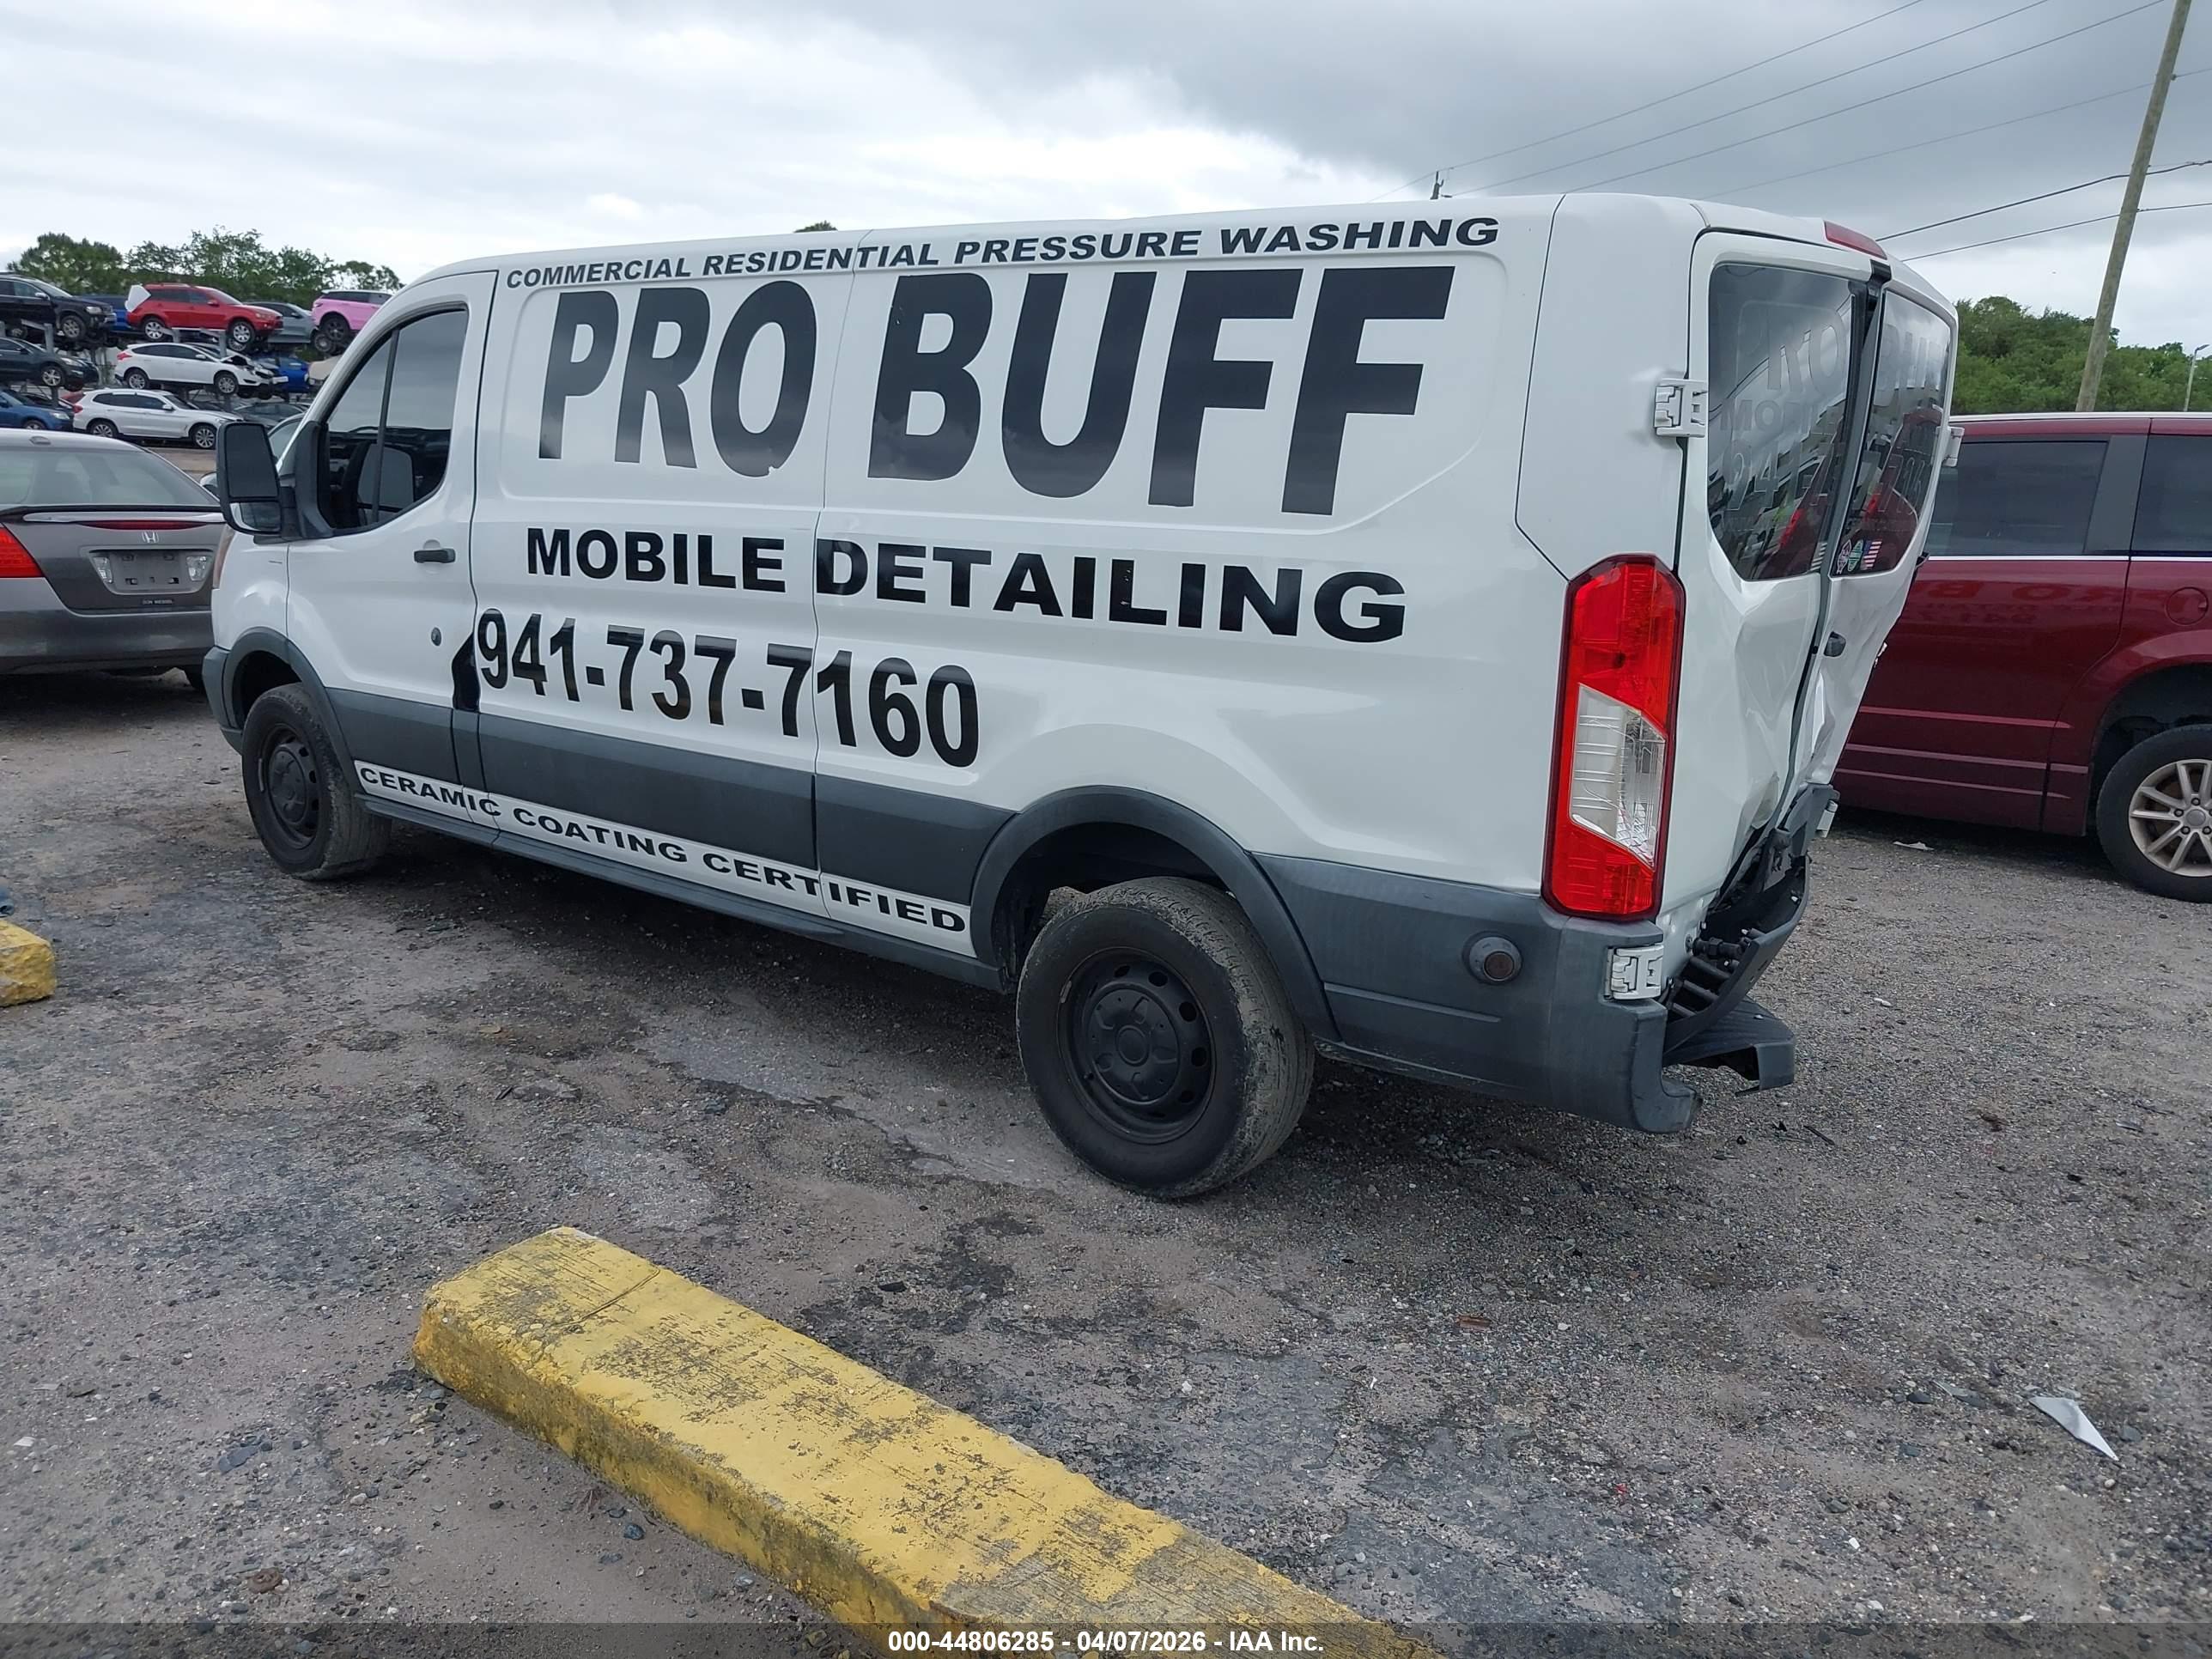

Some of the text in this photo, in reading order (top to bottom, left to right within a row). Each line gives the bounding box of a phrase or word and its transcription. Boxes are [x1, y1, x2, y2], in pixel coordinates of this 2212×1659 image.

[507, 217, 1500, 289] COMMERCIAL RESIDENTIAL PRESSURE WASHING
[538, 265, 1456, 516] PRO BUFF
[526, 526, 1407, 643] MOBILE DETAILING
[477, 606, 979, 768] 941-737-7160
[360, 767, 967, 933] CERAMIC COATING CERTIFIED
